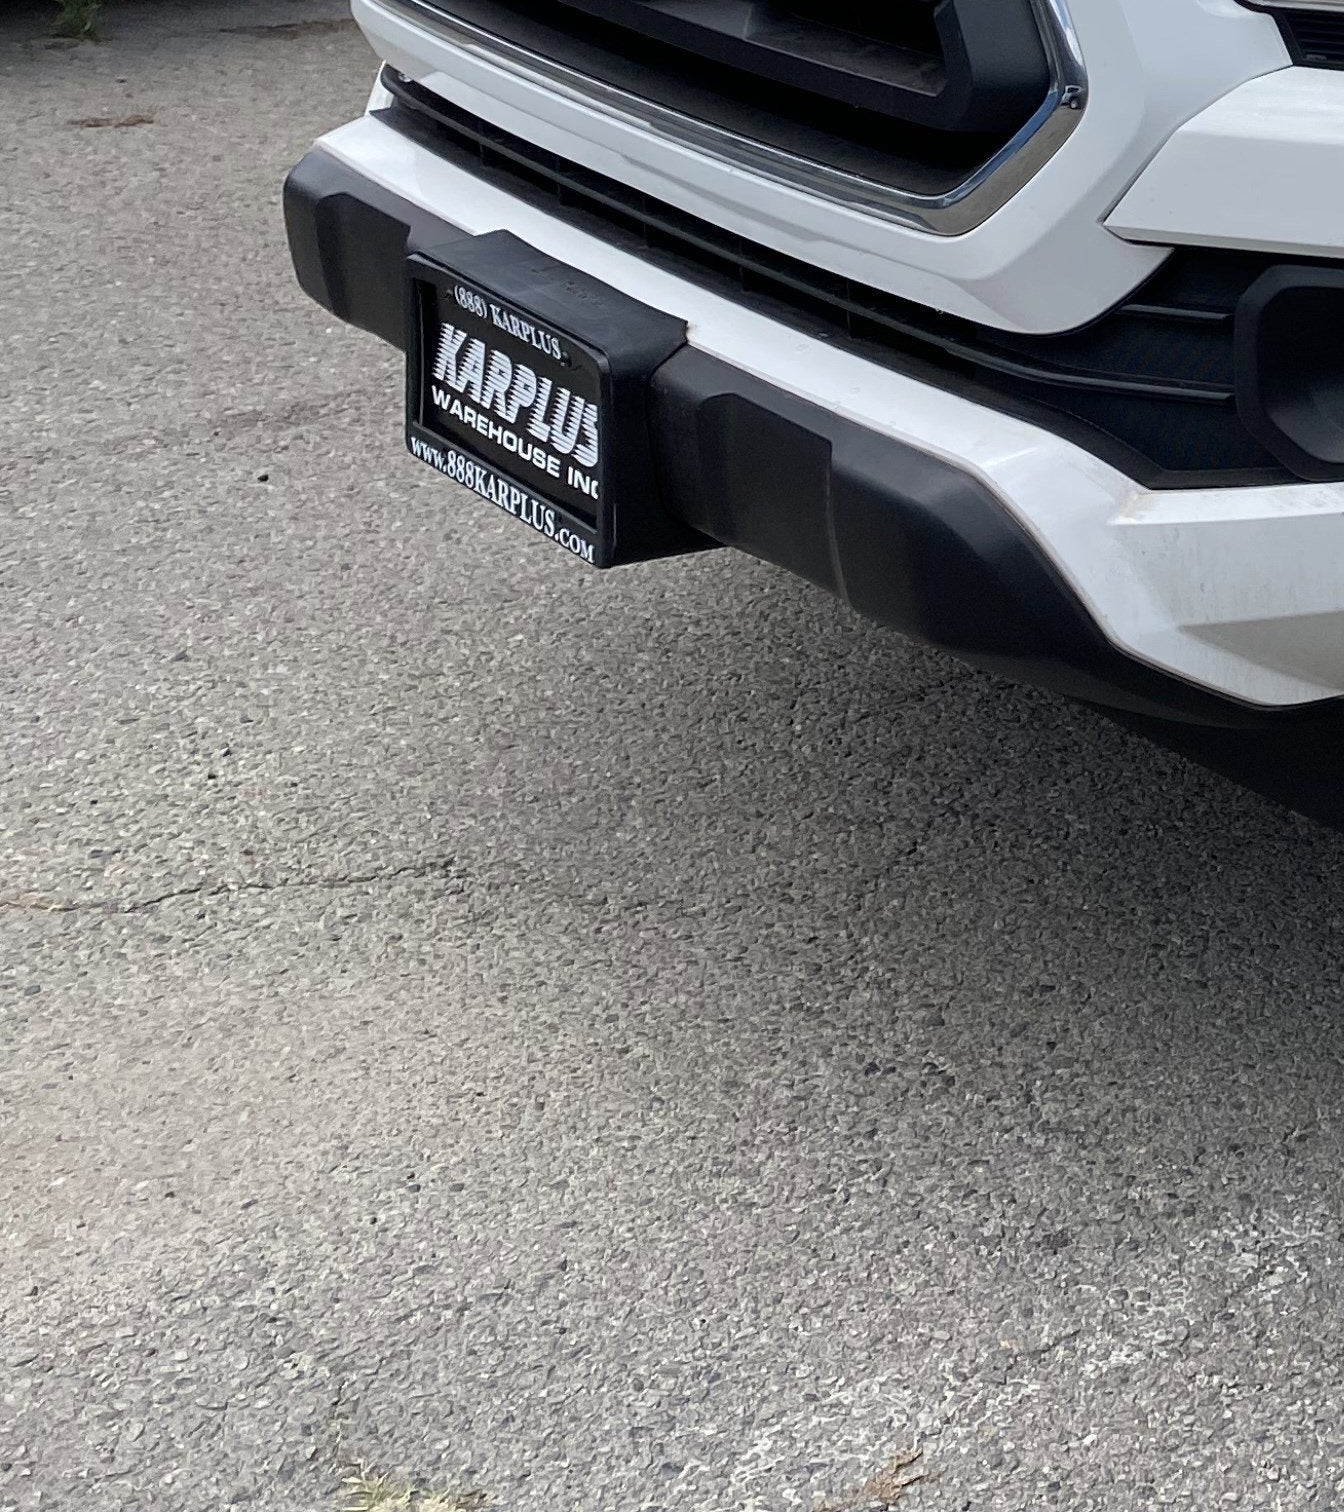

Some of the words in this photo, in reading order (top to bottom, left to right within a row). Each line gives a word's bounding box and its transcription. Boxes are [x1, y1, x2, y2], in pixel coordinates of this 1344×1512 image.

[454, 285, 488, 320] (888)
[489, 303, 562, 360] KARPLUS
[431, 322, 599, 468] KARPLUS
[431, 385, 561, 479] WAREHOUSE
